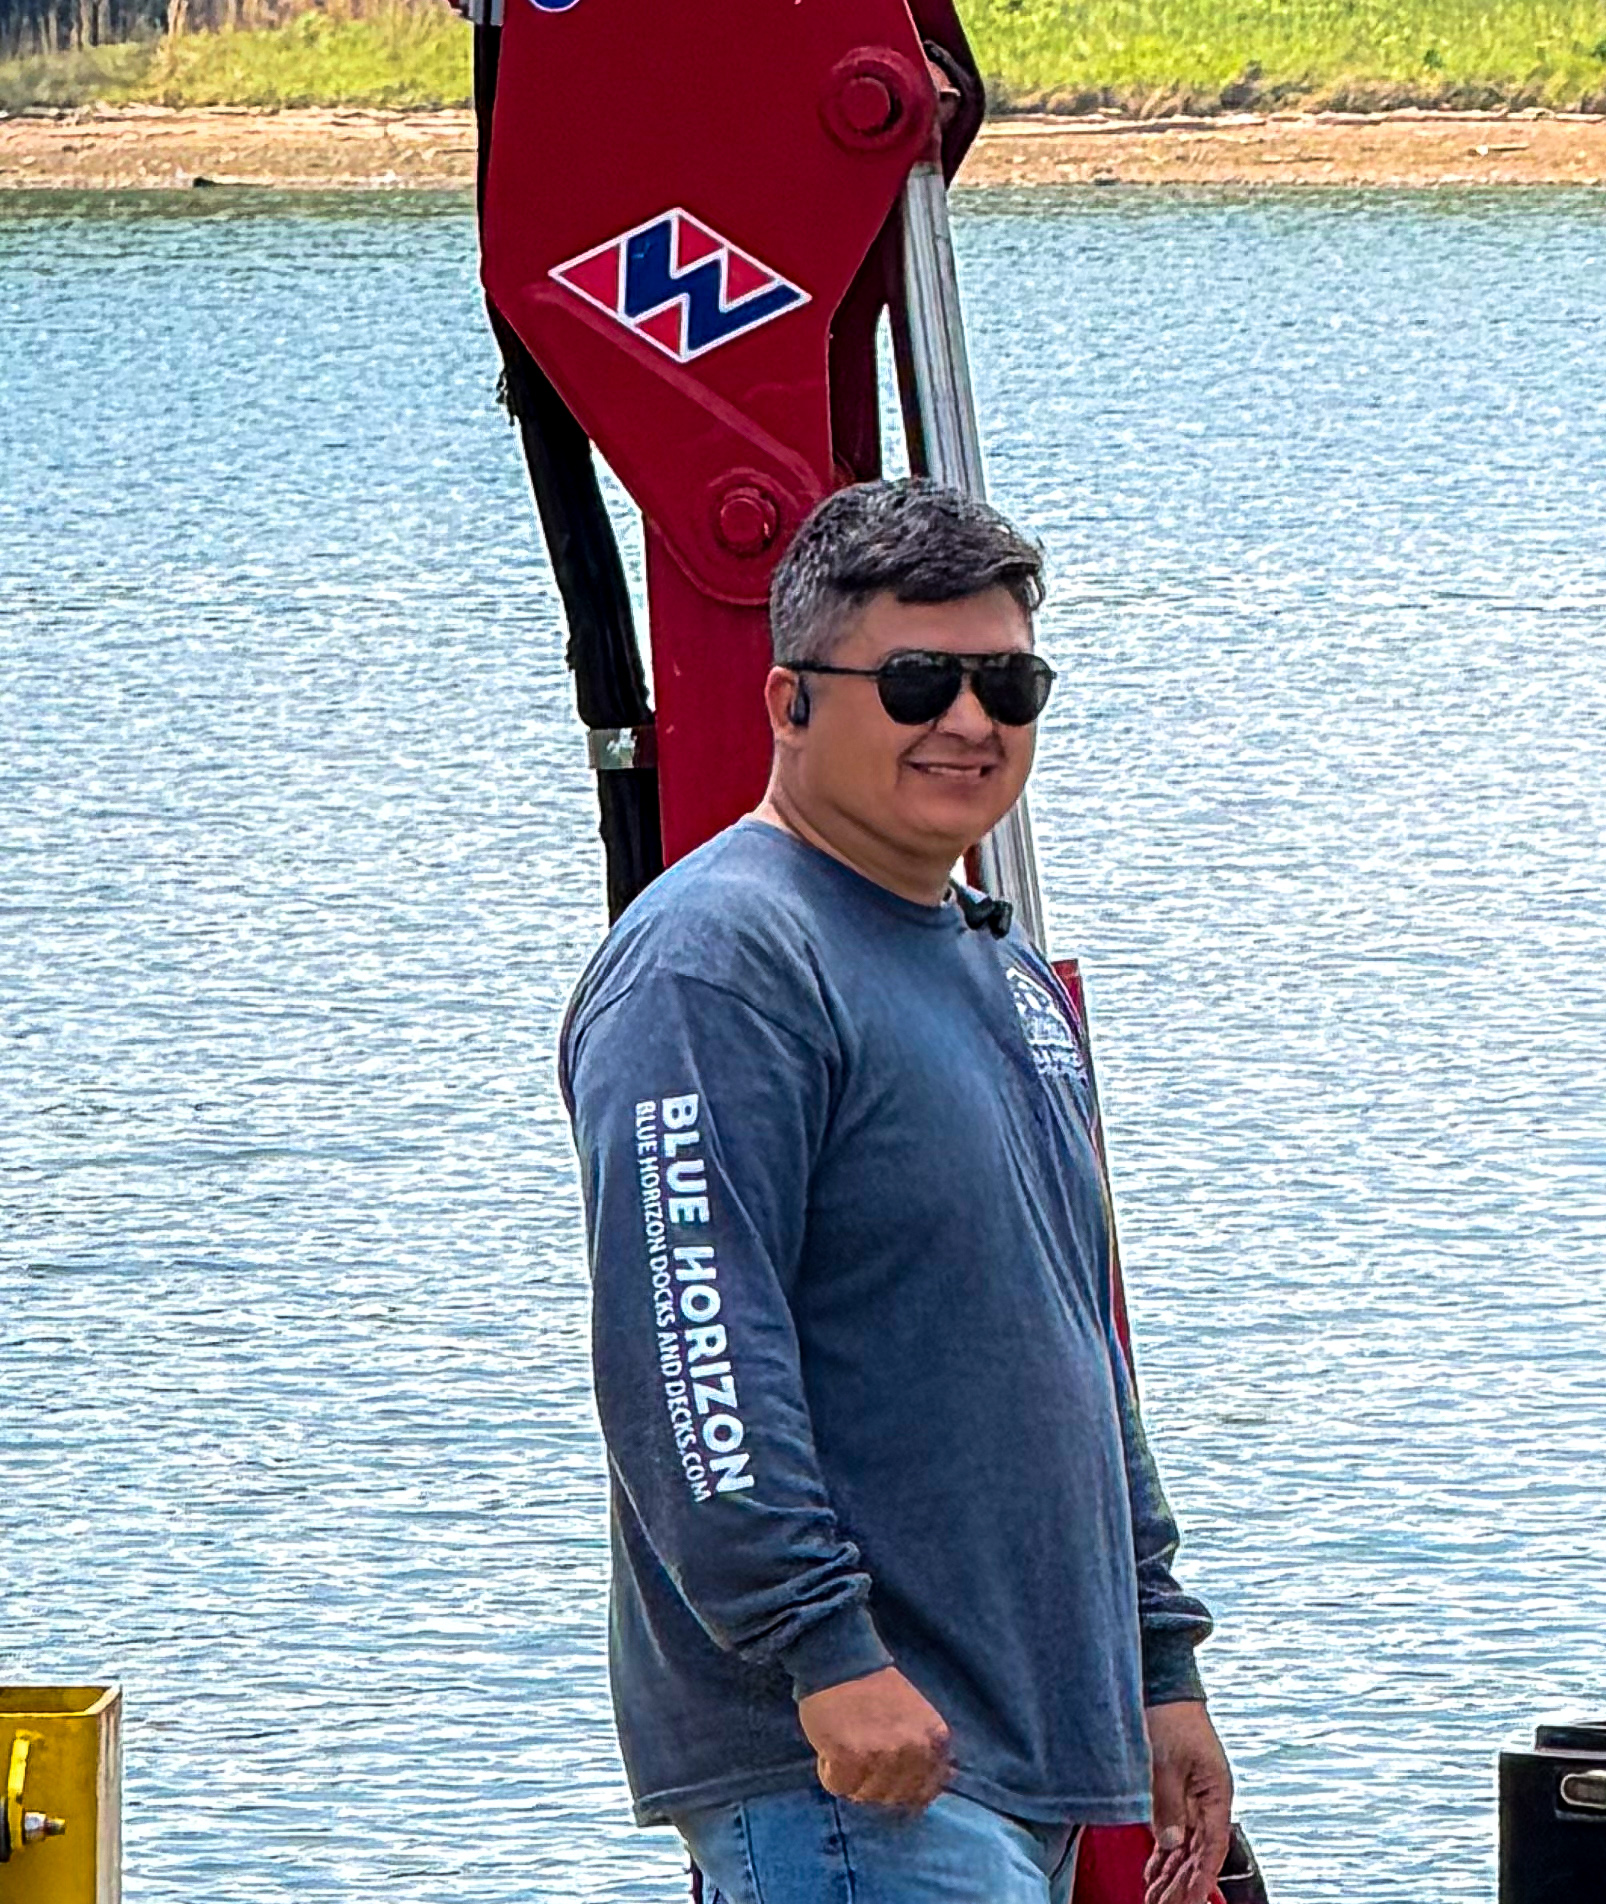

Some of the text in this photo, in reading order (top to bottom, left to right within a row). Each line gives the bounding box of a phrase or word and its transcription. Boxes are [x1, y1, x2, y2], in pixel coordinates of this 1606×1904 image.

[635, 1099, 713, 1504] BLUE HORIZON DOCKS AND DECKS.COM
[661, 1092, 756, 1493] BLUE HORIZON
